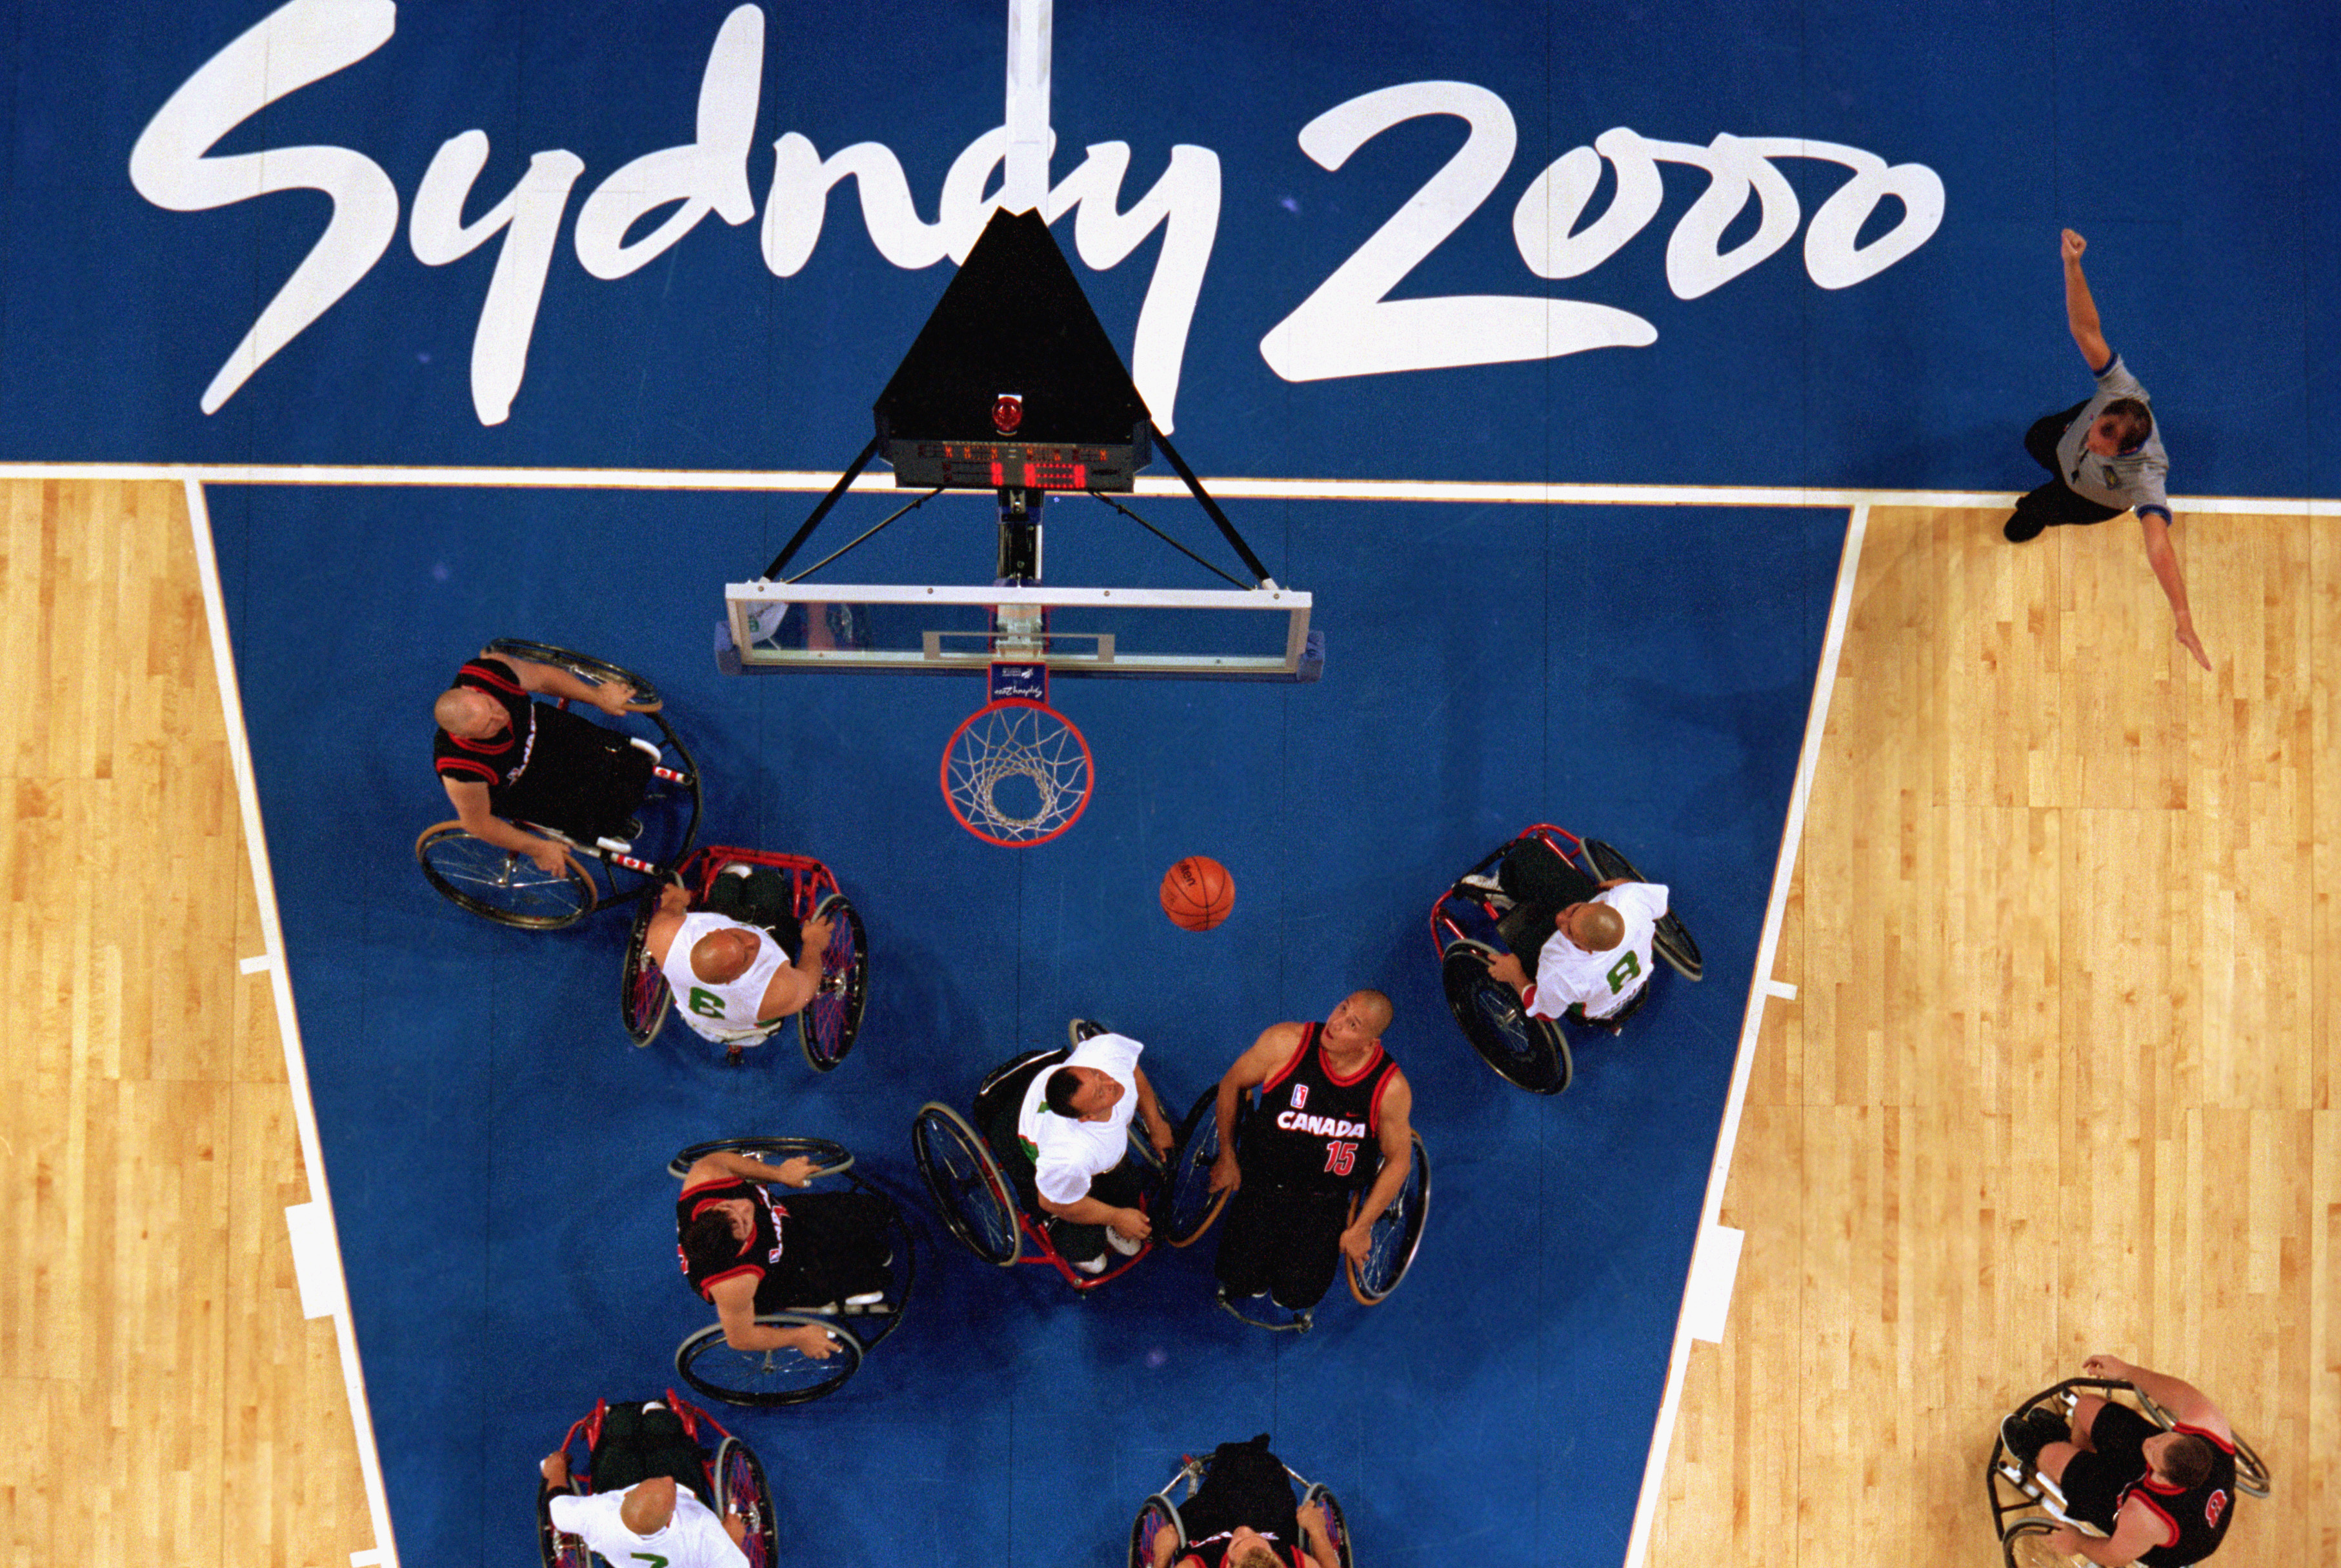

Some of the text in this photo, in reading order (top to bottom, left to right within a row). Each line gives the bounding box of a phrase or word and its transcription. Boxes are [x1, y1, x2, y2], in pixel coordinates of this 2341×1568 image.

[128, 0, 1945, 435] Sydney 2000
[990, 462, 1086, 489] 18
[1277, 1111, 1366, 1138] CANADA
[1324, 1140, 1359, 1176] 15
